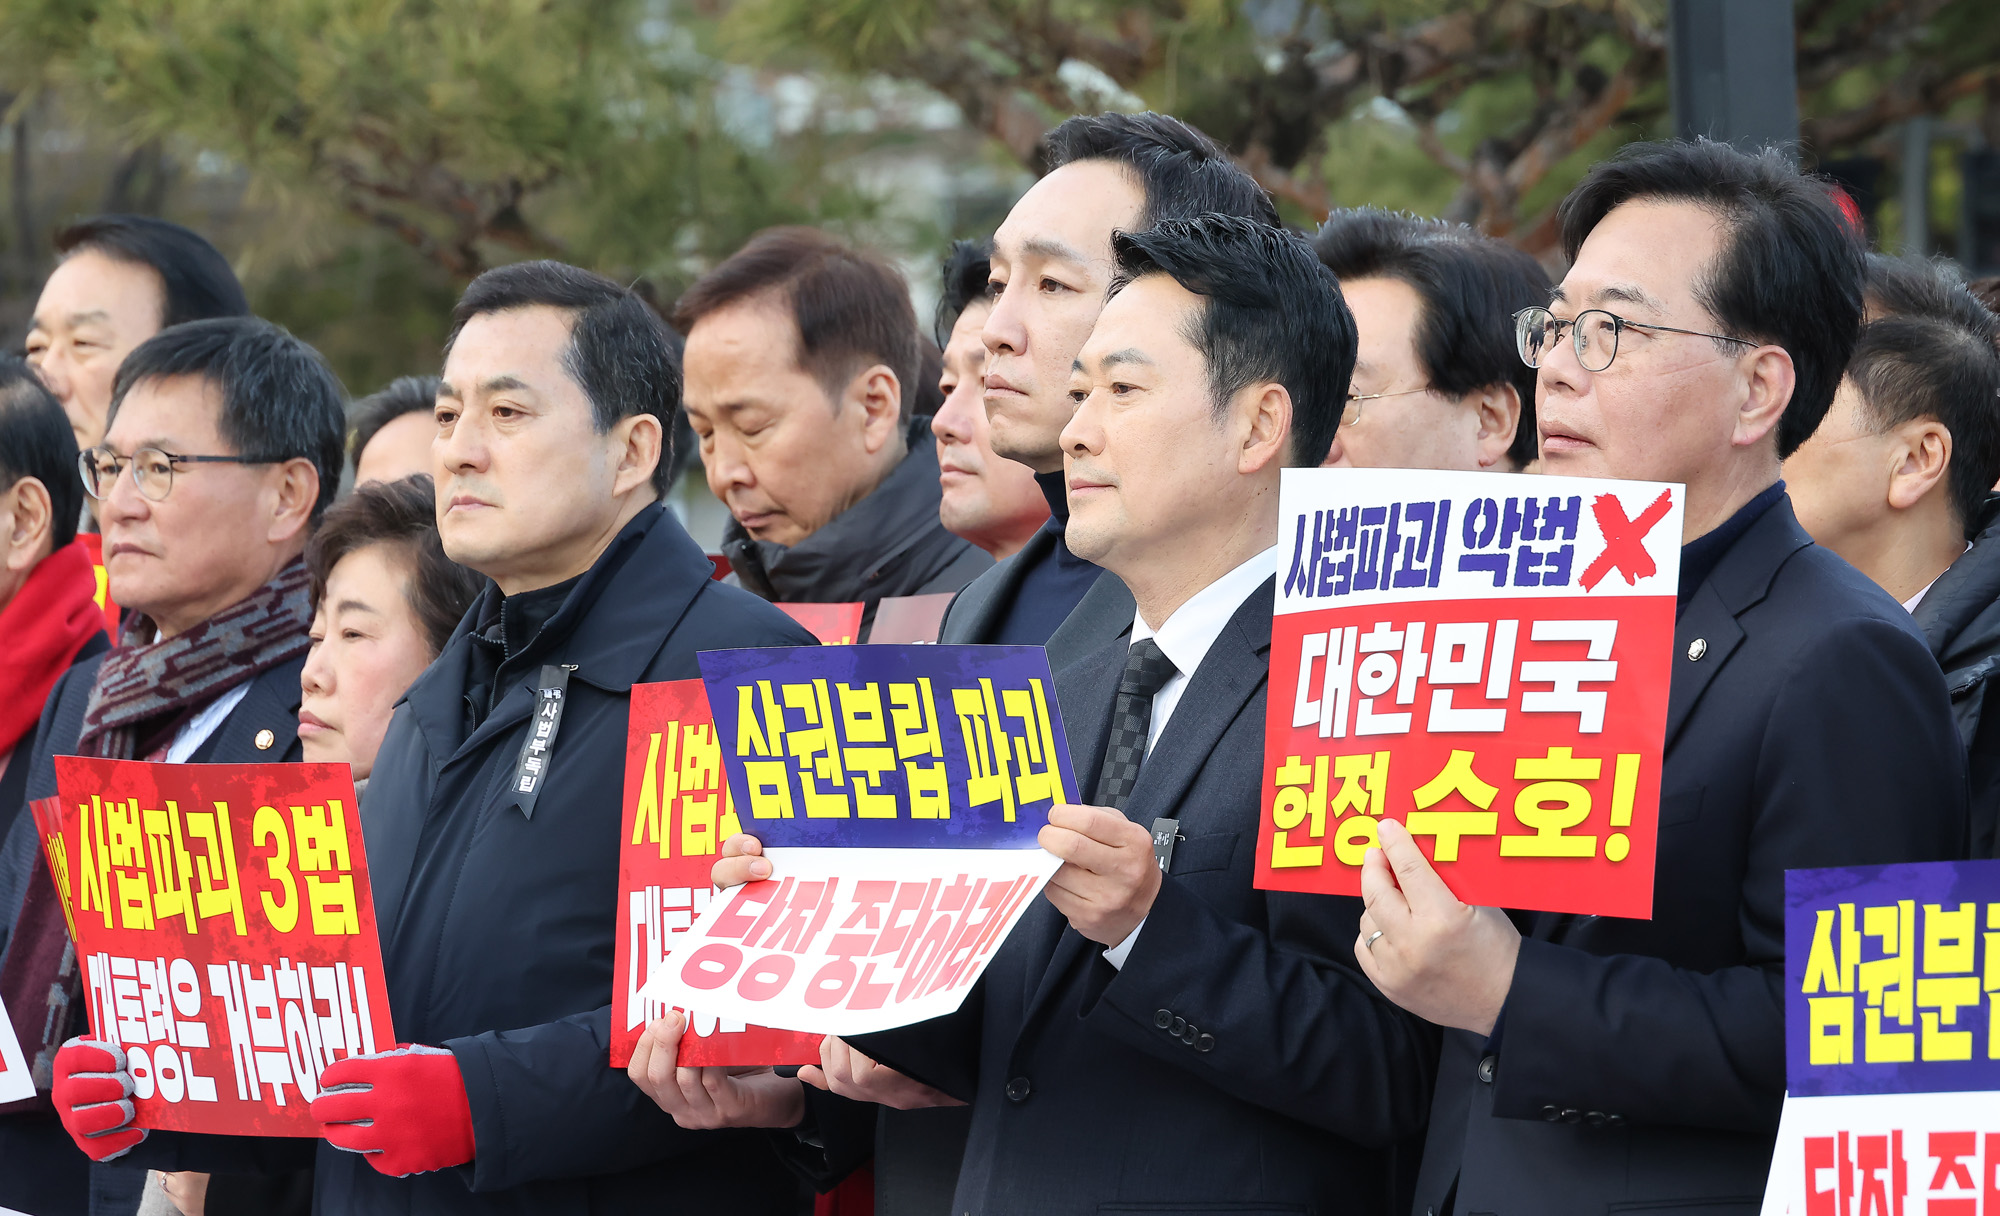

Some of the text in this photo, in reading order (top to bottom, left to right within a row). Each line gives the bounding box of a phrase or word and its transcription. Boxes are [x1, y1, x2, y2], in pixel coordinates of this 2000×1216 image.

[1284, 496, 1581, 598] 사법파괴 악법
[1292, 619, 1618, 739] 대한민국
[518, 702, 558, 793] 사법부독립
[735, 677, 1067, 823] 삼권분립 파괴
[1271, 746, 1641, 868] 헌정 수호!
[79, 794, 248, 936] 사법파괴
[252, 799, 360, 935] 3법
[681, 876, 839, 1001] 당장
[804, 874, 1040, 1010] 중단하라!
[87, 951, 376, 1106] 대통령은 거부하라!
